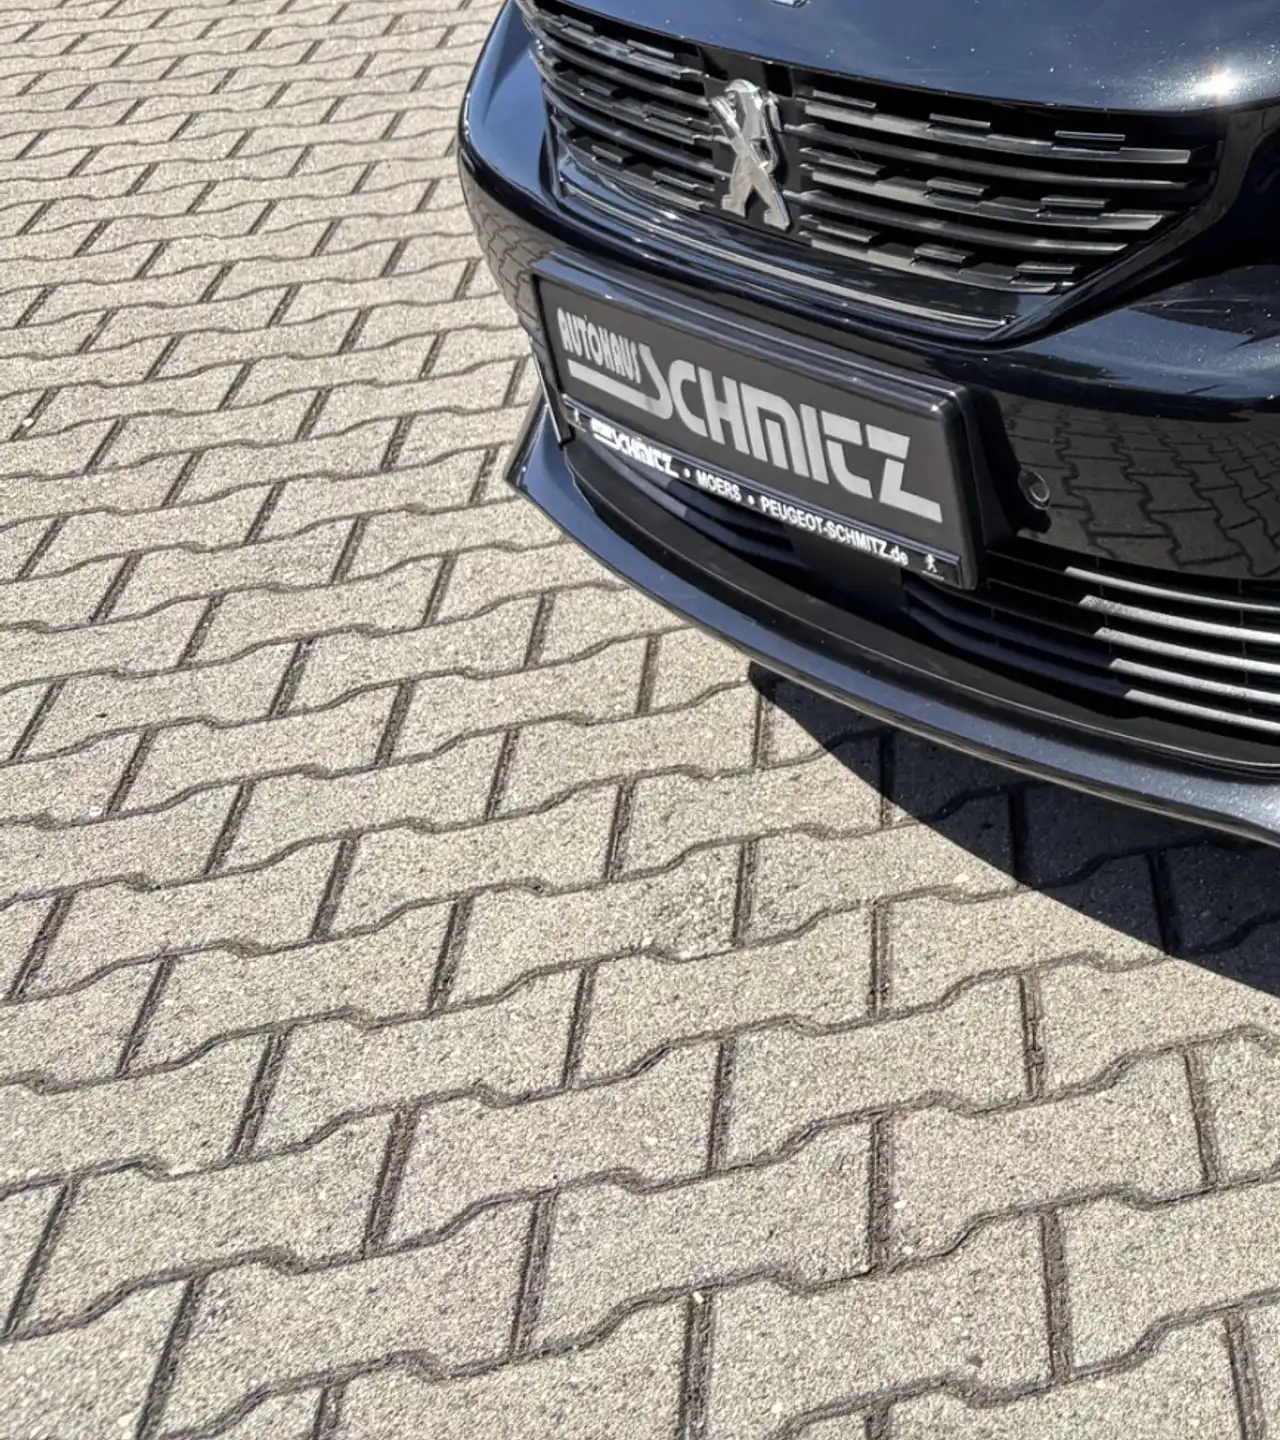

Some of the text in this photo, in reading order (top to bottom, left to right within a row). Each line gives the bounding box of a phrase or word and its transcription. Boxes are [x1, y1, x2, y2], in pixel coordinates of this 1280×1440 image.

[557, 306, 641, 384] AUTOHAUS
[566, 342, 943, 524] SCHMITZ
[696, 469, 742, 502] MOERS
[760, 495, 909, 567] PEUGEOT-SCHMITZ.de
